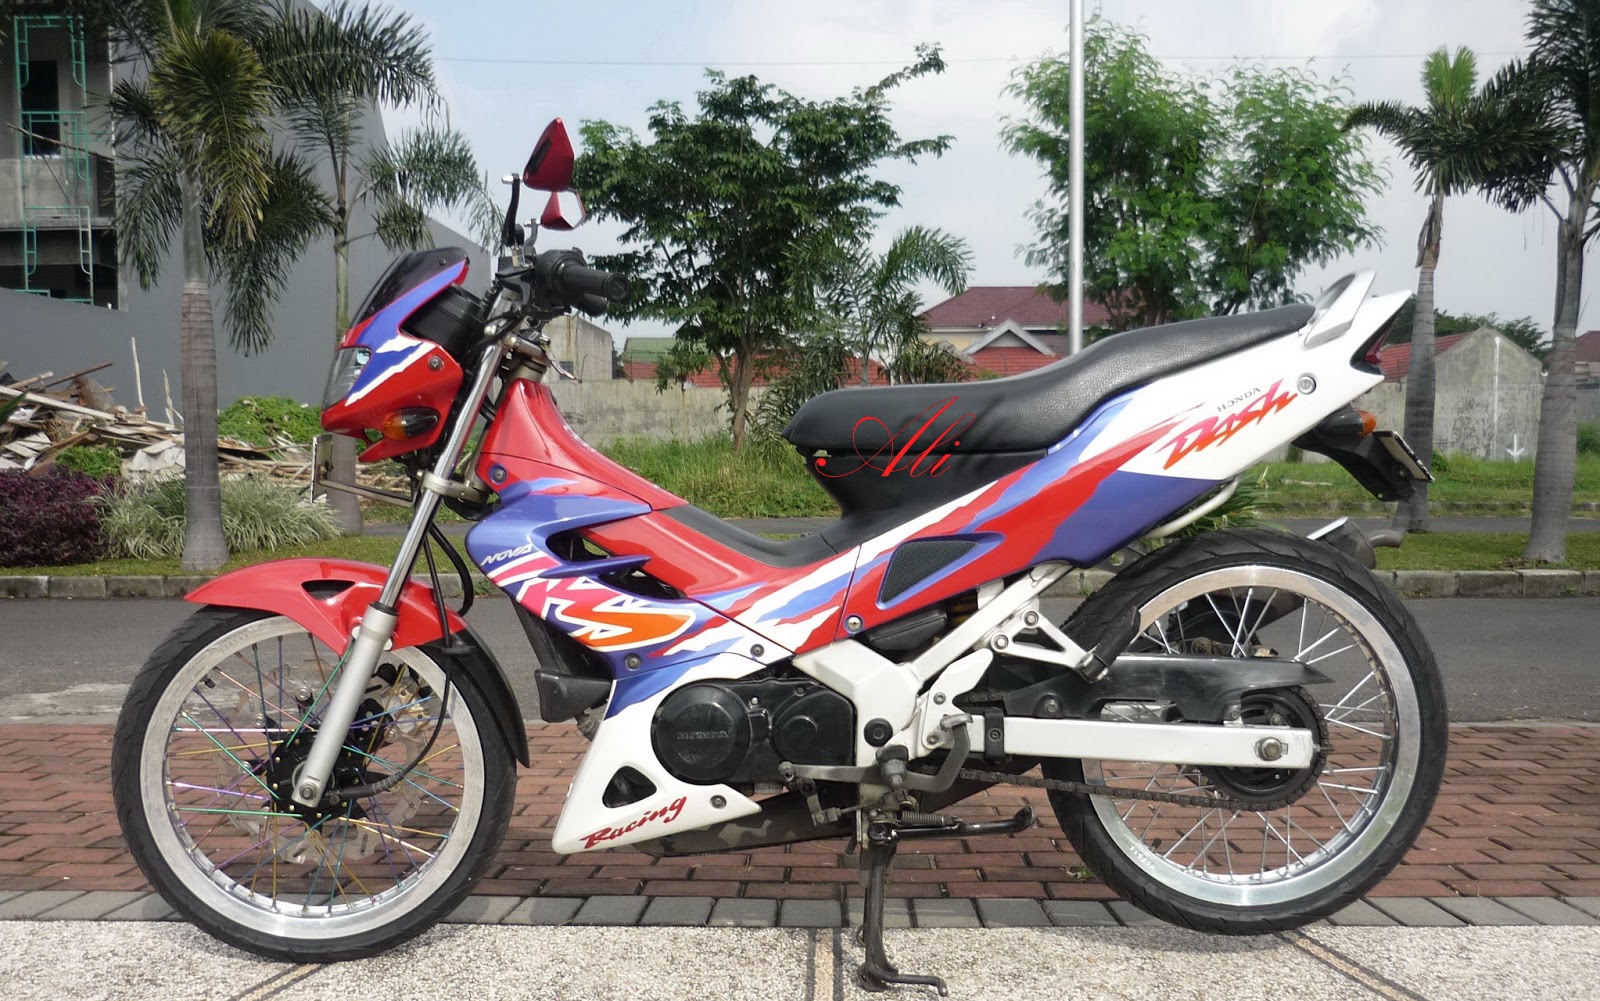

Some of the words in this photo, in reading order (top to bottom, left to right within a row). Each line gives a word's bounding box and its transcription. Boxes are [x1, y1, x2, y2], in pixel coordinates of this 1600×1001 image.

[1217, 387, 1261, 412] HONDA
[480, 543, 533, 567] NOVA
[579, 796, 687, 849] Racing
